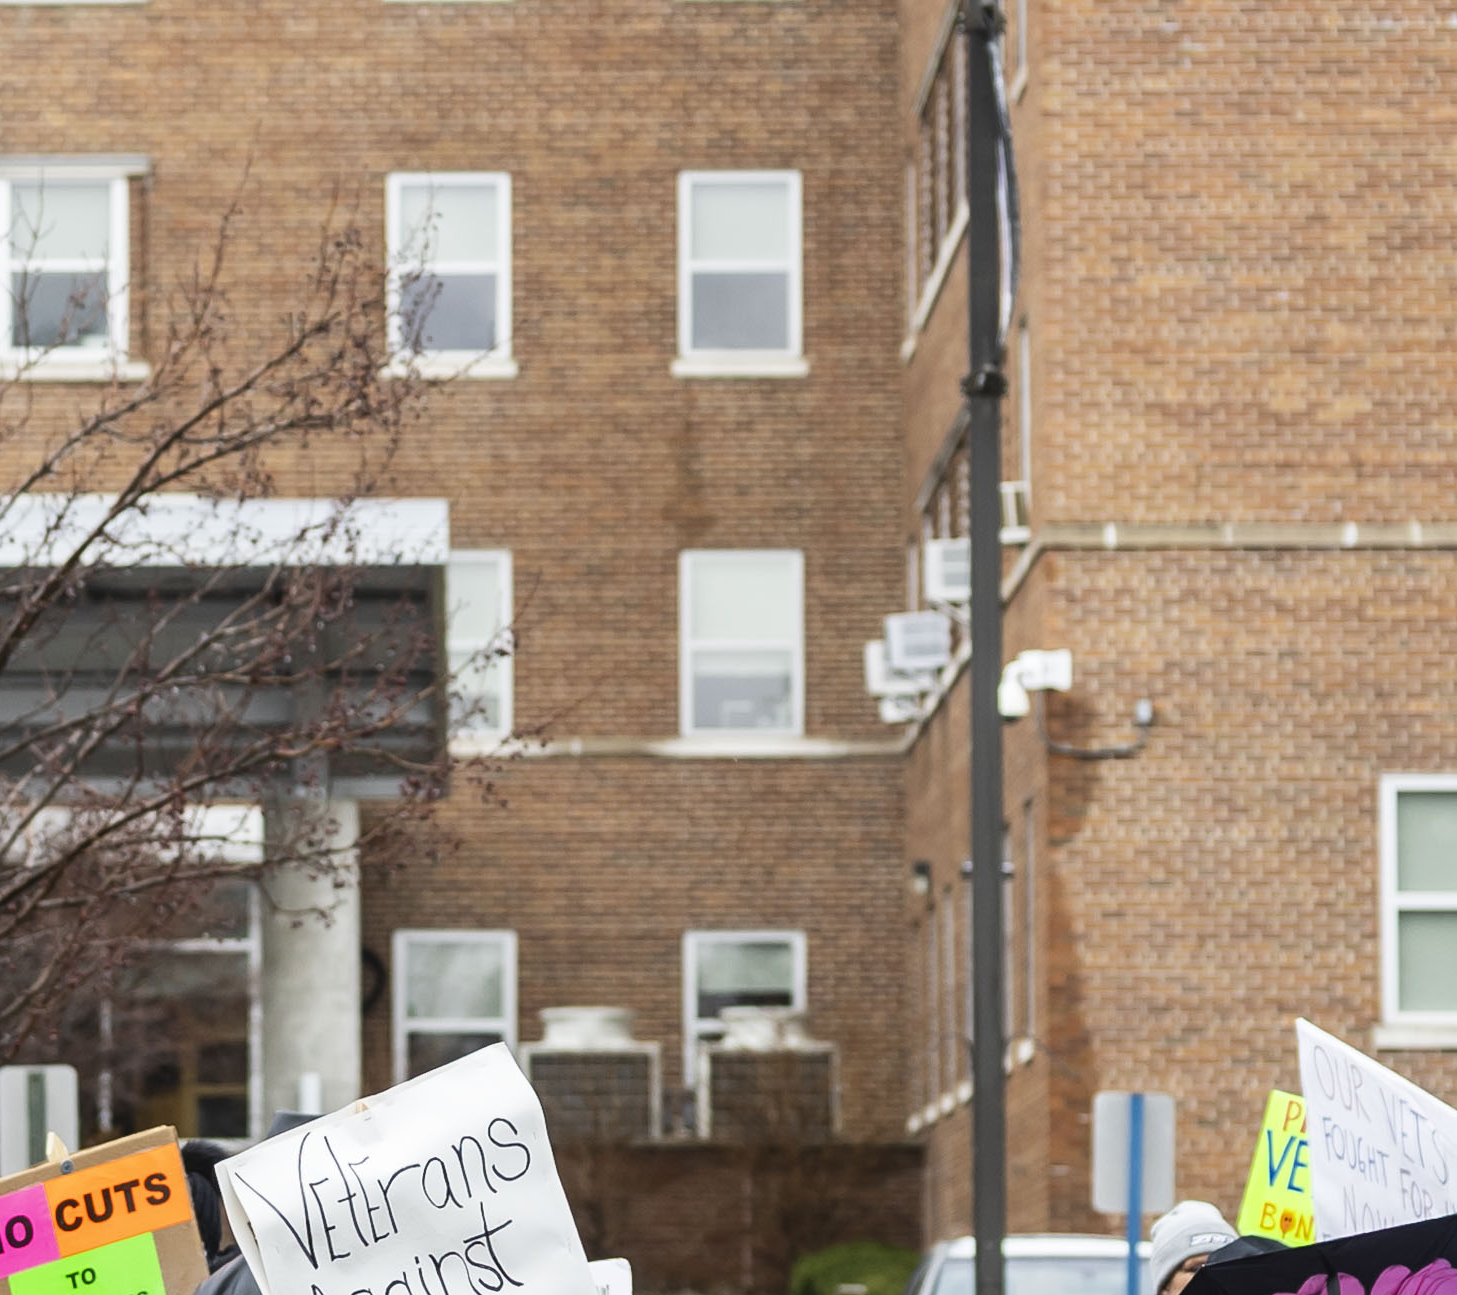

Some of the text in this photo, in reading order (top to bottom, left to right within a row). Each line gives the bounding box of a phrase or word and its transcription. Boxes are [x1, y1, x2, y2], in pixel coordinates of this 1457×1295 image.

[1313, 1044, 1448, 1186] OUR VETS
[1322, 1116, 1389, 1189] FOUGHT
[55, 1173, 171, 1232] CUTS
[66, 1267, 97, 1289] TO
